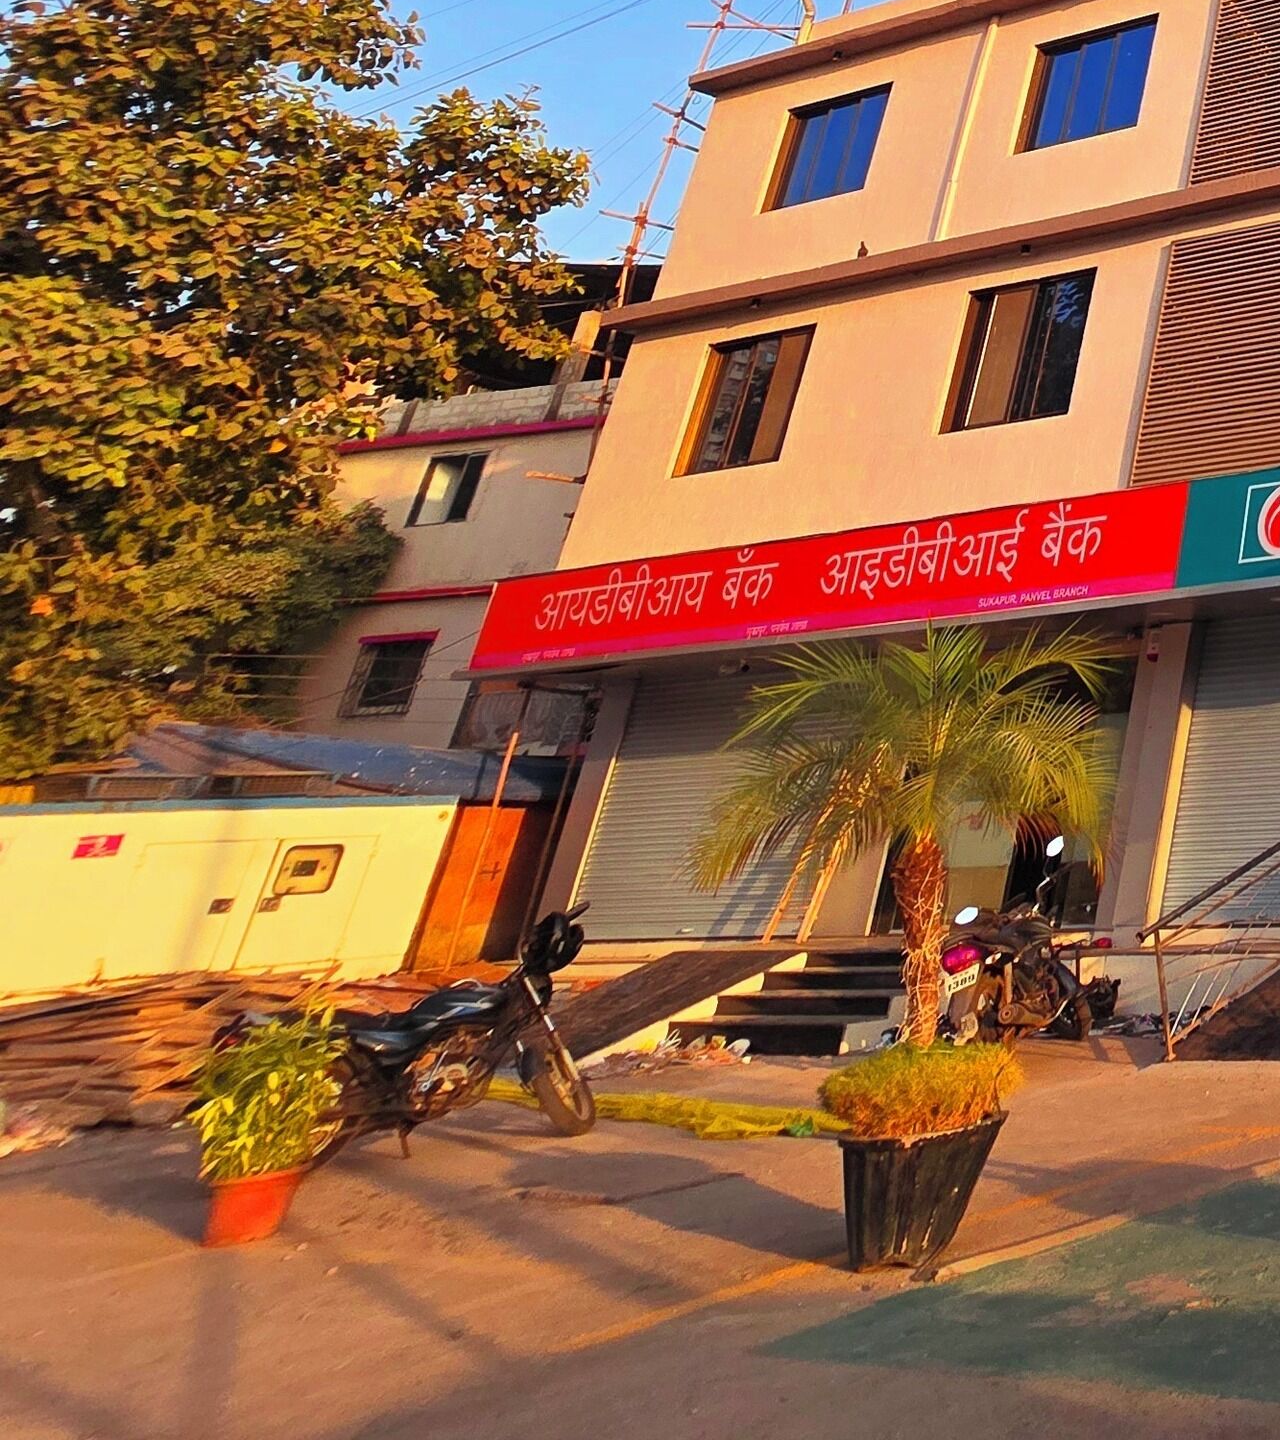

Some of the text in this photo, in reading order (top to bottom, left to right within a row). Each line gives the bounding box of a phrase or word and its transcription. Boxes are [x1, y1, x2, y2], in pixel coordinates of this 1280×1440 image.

[534, 548, 780, 631] आयडीबीआय बँक
[820, 501, 1108, 601] आइडीबीआई बैंक
[1020, 590, 1051, 604] PANVEL
[1053, 585, 1089, 599] BRANCH
